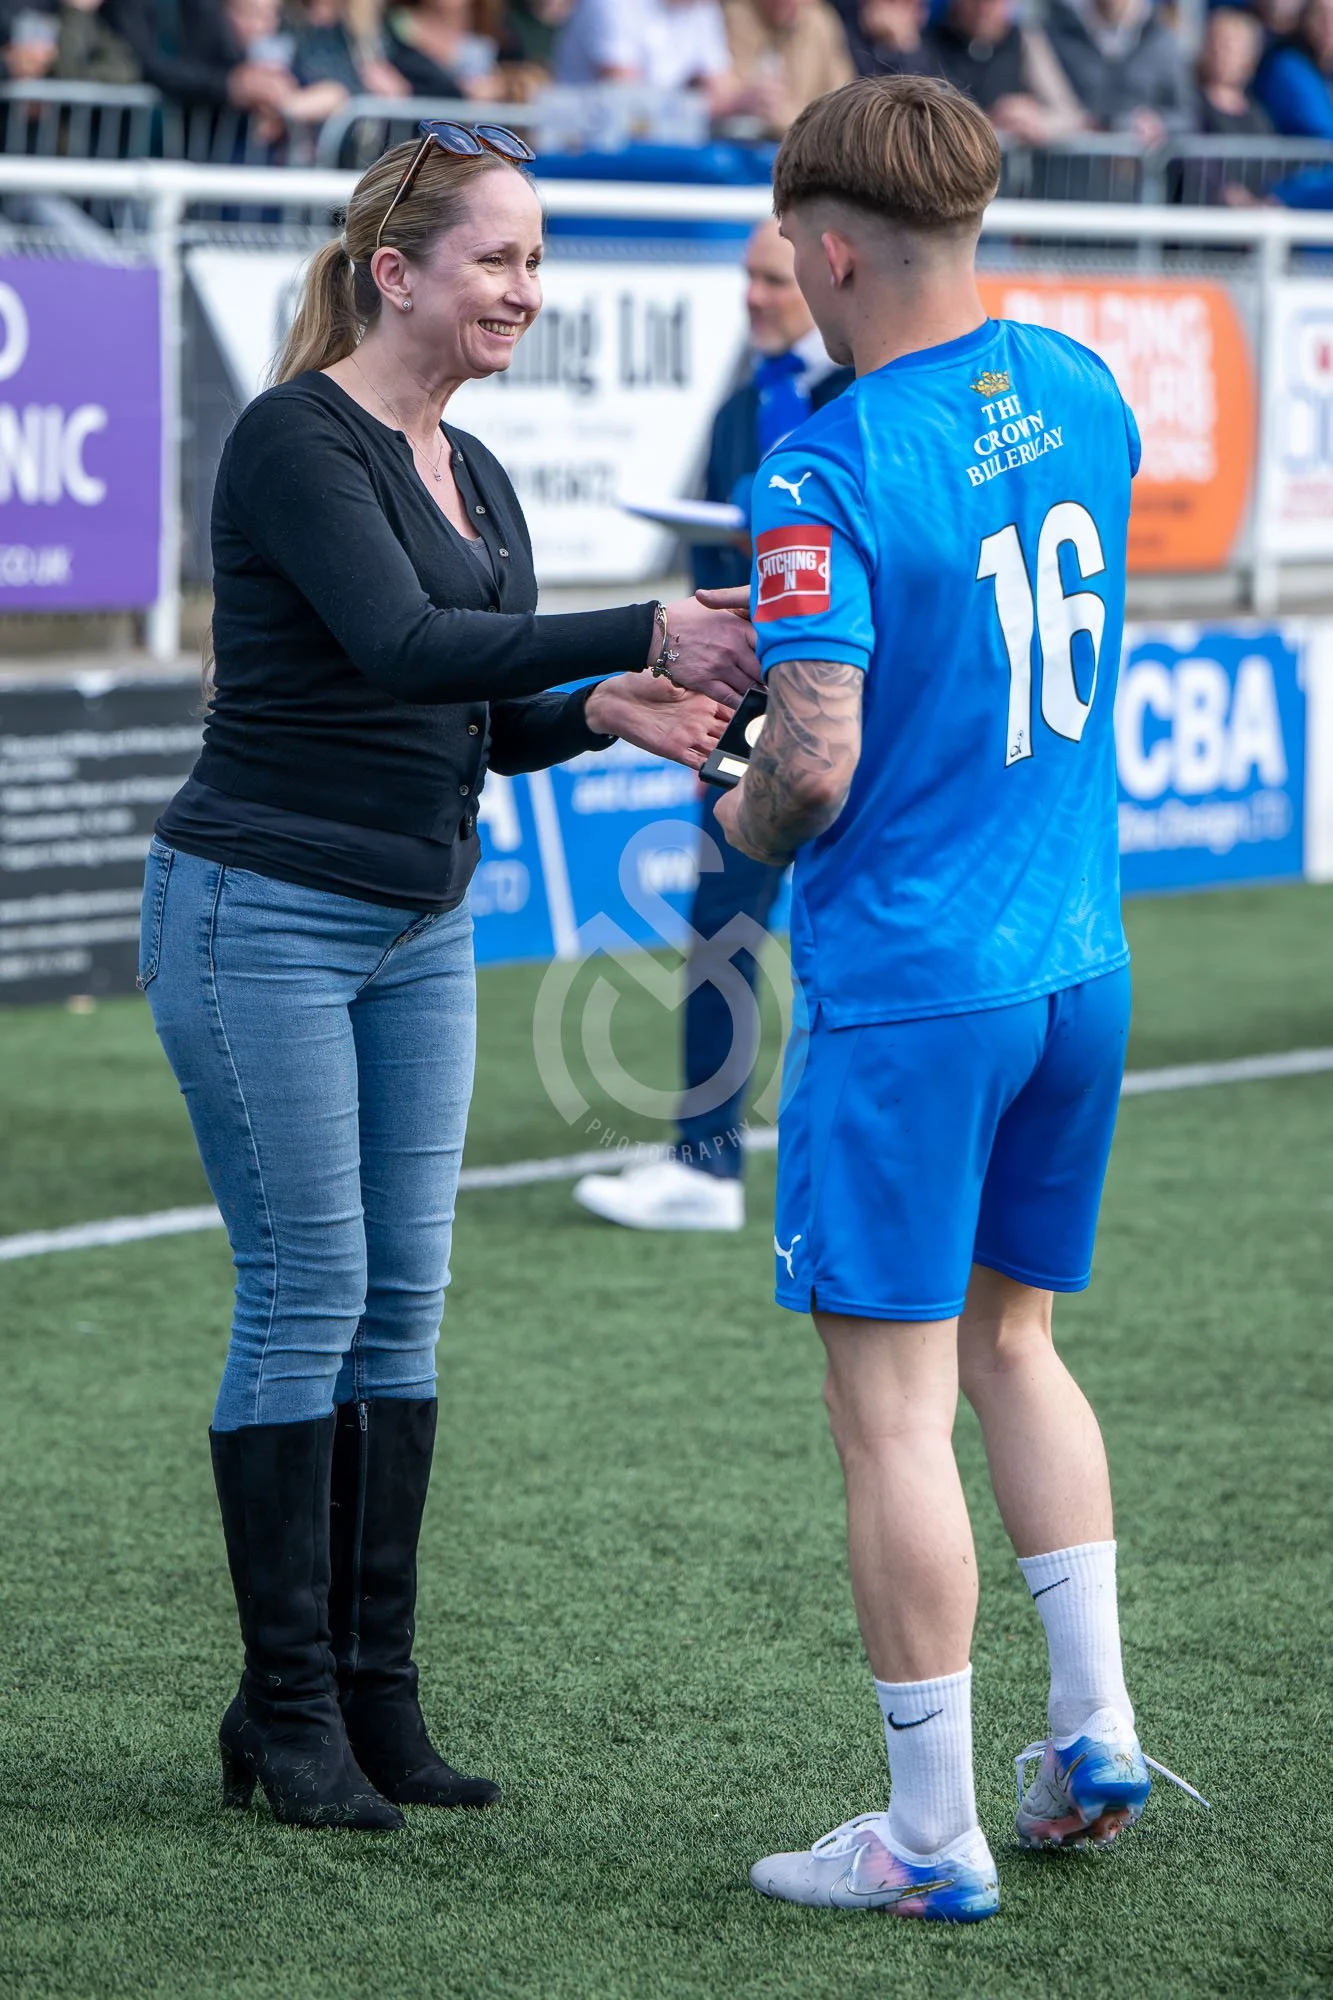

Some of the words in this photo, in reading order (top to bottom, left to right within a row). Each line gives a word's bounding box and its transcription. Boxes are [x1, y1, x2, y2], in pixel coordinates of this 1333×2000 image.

[973, 410, 1045, 456] CROWN
[762, 550, 817, 579] PITCHING
[783, 571, 797, 591] IN
[976, 500, 1106, 768] 16
